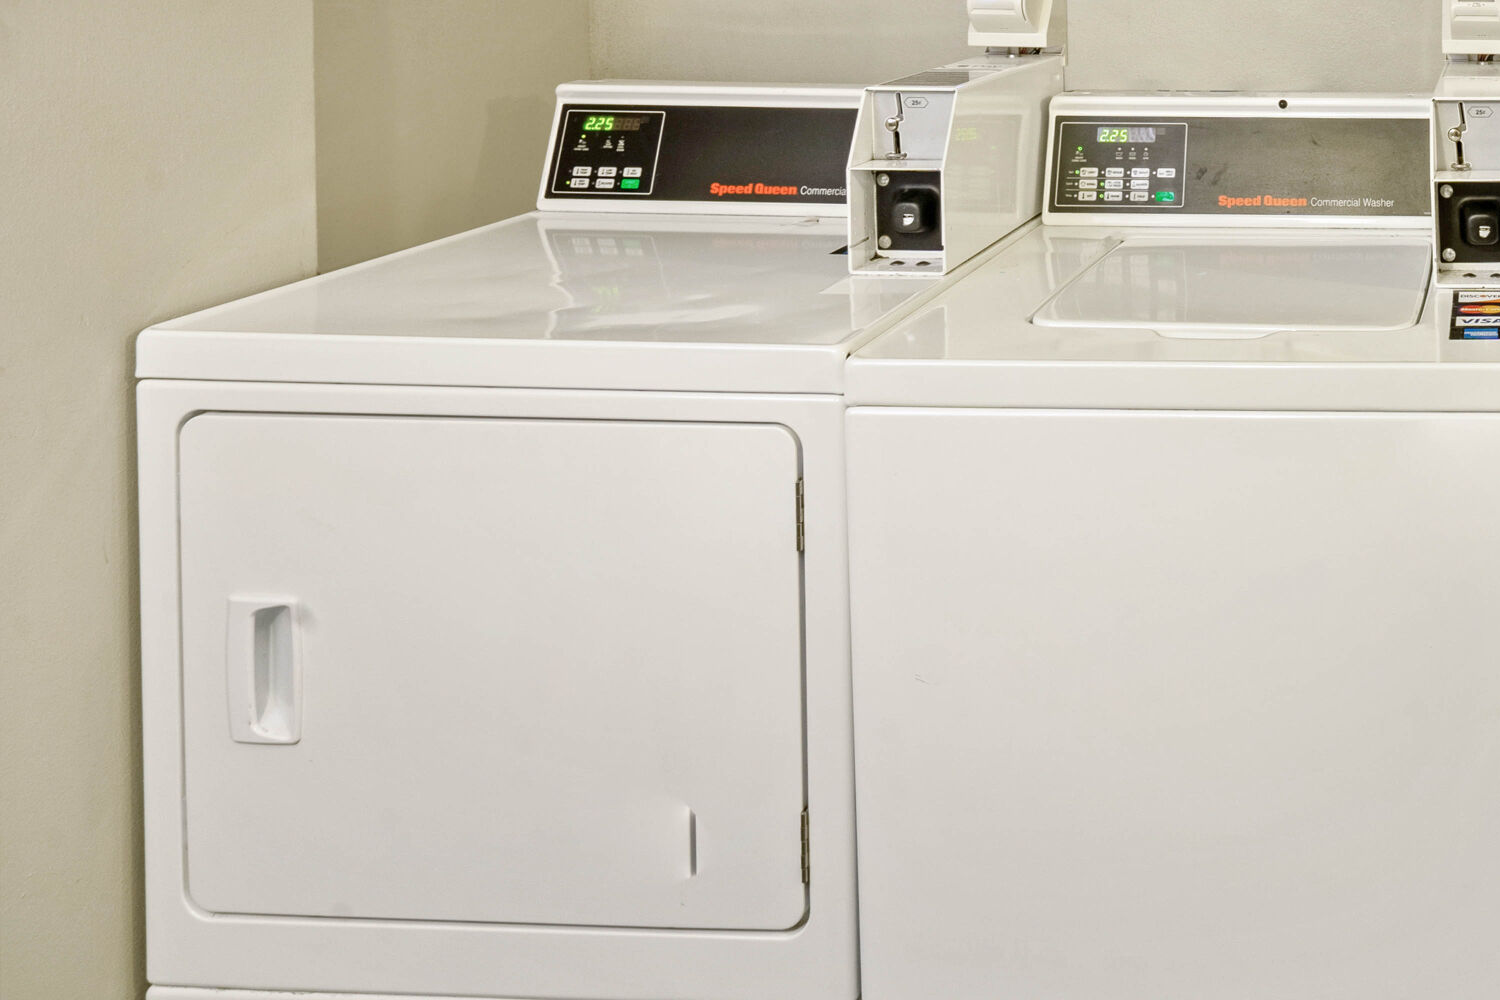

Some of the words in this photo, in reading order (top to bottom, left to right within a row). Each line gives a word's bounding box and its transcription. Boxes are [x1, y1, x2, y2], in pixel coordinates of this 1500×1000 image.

[584, 116, 615, 131] 2.25
[1099, 129, 1128, 143] 2.25
[710, 182, 753, 196] Speed
[754, 182, 798, 196] Queen
[800, 185, 847, 196] Commercia
[1218, 195, 1261, 208] Speed
[1263, 195, 1307, 207] Queen
[1310, 197, 1361, 207] Commercial
[1363, 197, 1395, 208] Washer
